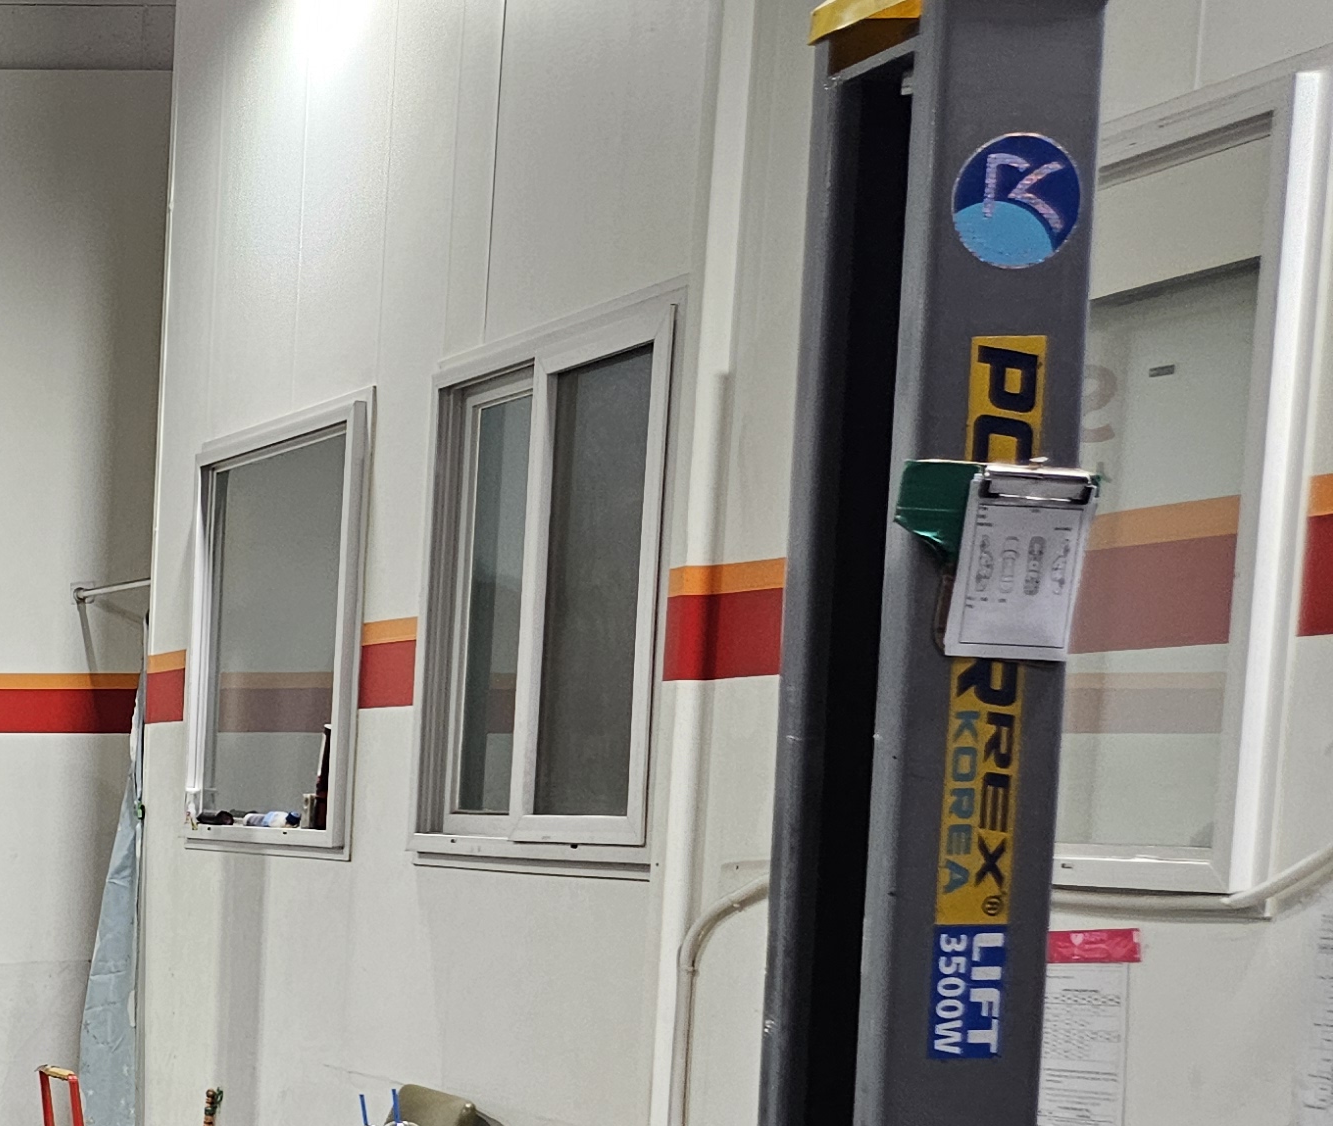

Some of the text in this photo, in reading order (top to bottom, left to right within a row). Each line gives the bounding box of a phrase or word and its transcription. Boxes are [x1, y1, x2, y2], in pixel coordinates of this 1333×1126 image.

[942, 709, 979, 894] KOREA
[933, 932, 968, 1058] 3500W
[971, 930, 1001, 1055] LIFT
